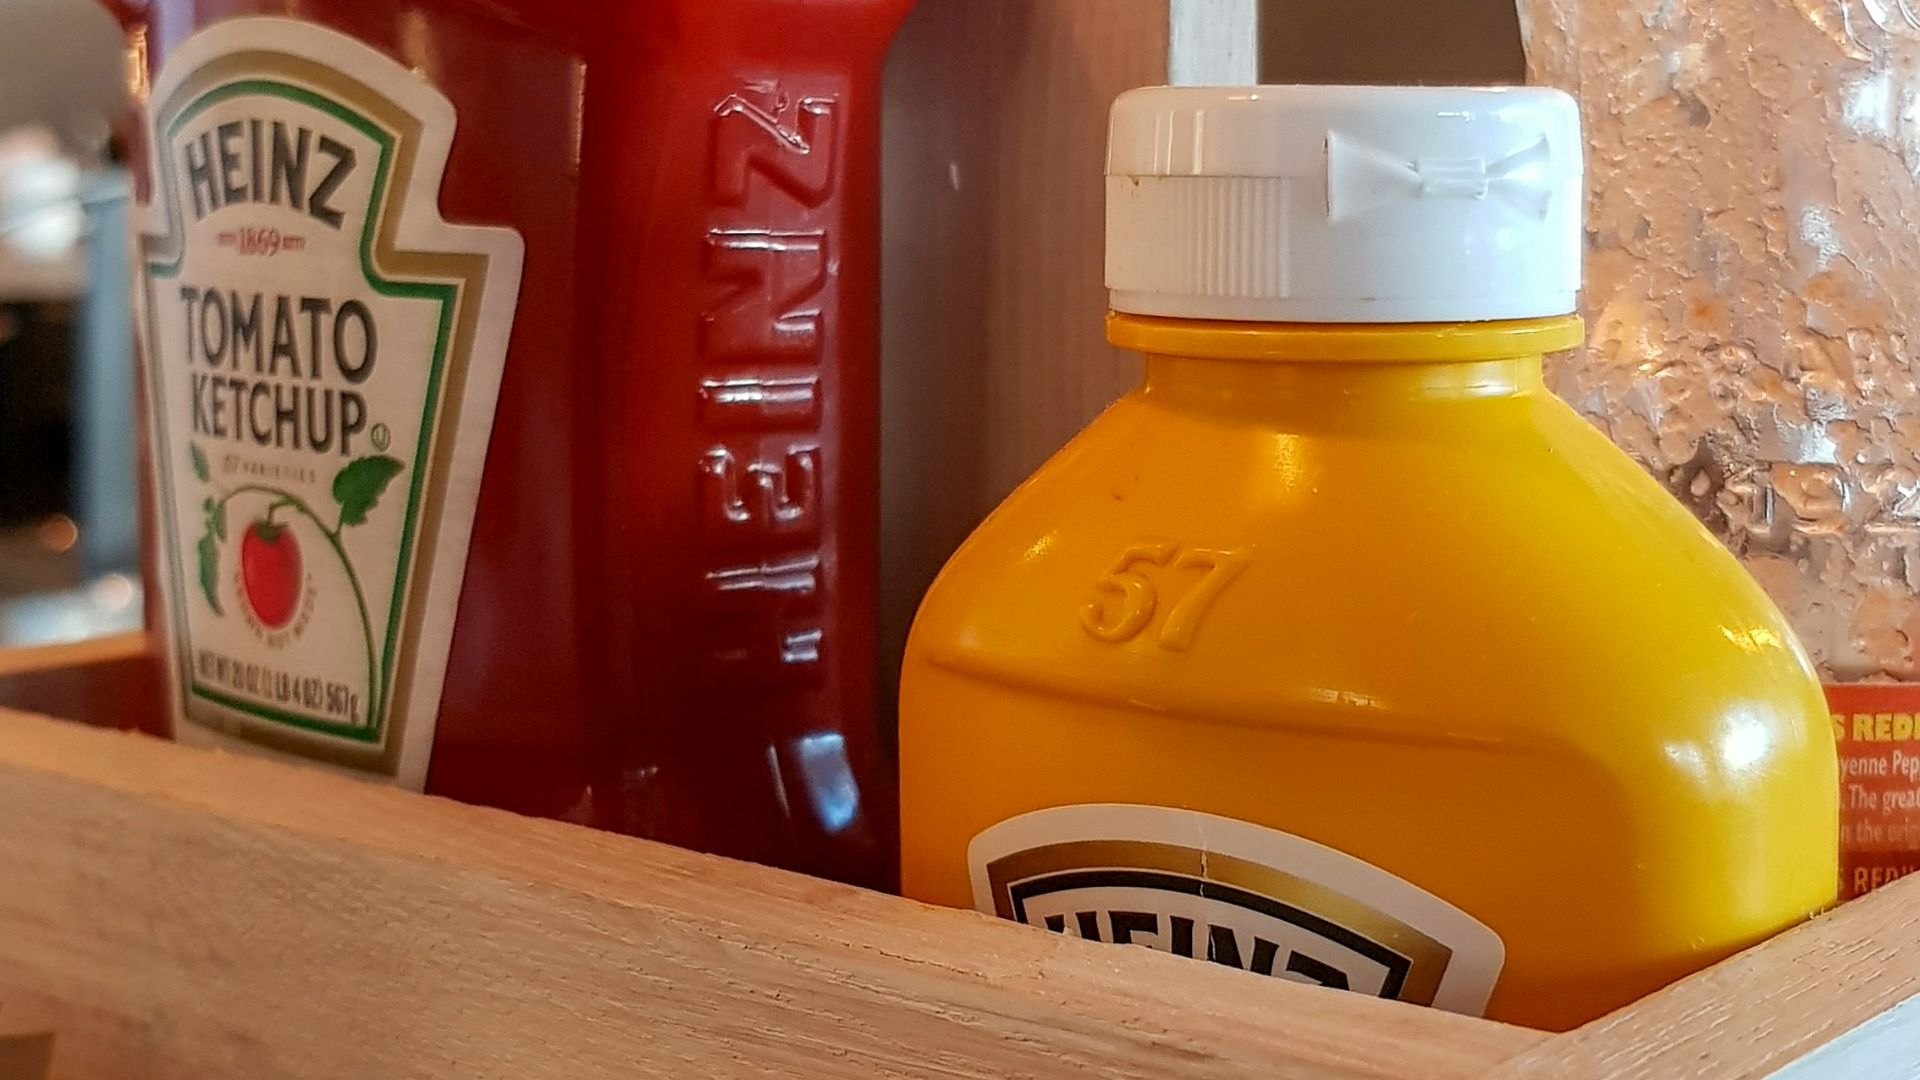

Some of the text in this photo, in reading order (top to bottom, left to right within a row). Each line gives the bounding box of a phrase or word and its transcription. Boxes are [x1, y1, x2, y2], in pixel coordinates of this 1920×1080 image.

[184, 116, 358, 231] HEINZ
[238, 226, 281, 257] 1869
[180, 285, 379, 385] TOMATO
[191, 372, 368, 457] KETCHUP
[702, 90, 841, 690] HEINZ
[1079, 541, 1254, 653] 57
[1848, 784, 1877, 809] The
[1892, 749, 1920, 783] Pep
[1854, 865, 1914, 894] RED
